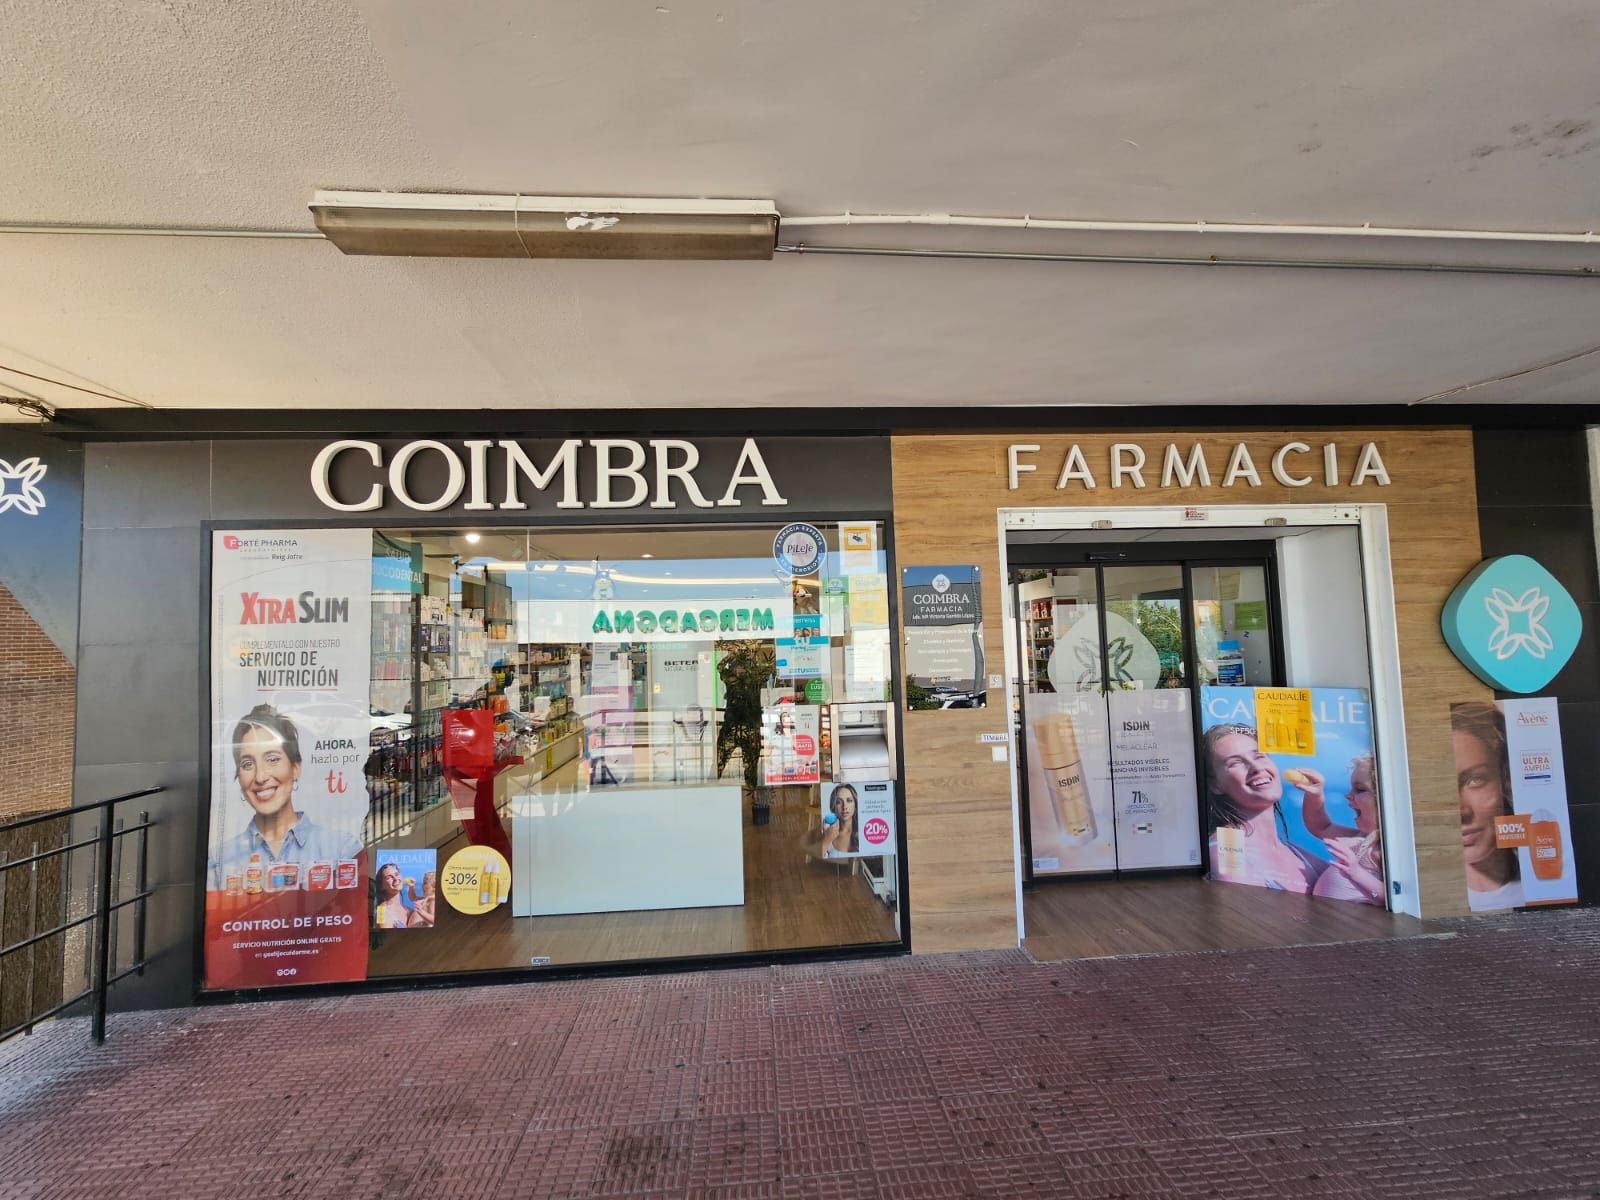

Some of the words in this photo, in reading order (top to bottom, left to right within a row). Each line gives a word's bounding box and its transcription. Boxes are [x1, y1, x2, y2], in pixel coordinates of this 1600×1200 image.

[1008, 441, 1392, 491] FARMACIA
[310, 437, 788, 512] COIMBRA
[261, 539, 298, 547] PHARMA
[913, 593, 970, 605] COIMBRA
[920, 605, 963, 613] FARMACIA
[240, 651, 296, 668] SERVICIO
[300, 650, 318, 666] DE
[257, 665, 338, 687] NUTRICIÓN
[1208, 695, 1367, 725] CALÍE
[1123, 720, 1151, 731] ISDIN
[315, 739, 357, 750] AHORA,
[311, 753, 339, 764] hazlo
[342, 754, 361, 765] por
[1522, 757, 1550, 765] ULTRA
[1524, 764, 1551, 772] AMPLIA
[324, 769, 348, 794] ti
[1058, 774, 1080, 788] ISDIN
[1131, 790, 1149, 803] 71%
[865, 821, 888, 836] 20%
[1497, 823, 1526, 834] 100%
[444, 872, 478, 886] -30%
[222, 919, 289, 932] CONTROL
[293, 917, 312, 928] DE
[316, 915, 353, 926] PESO
[261, 939, 296, 948] NUTRICIÓN
[296, 937, 319, 945] ONLINE
